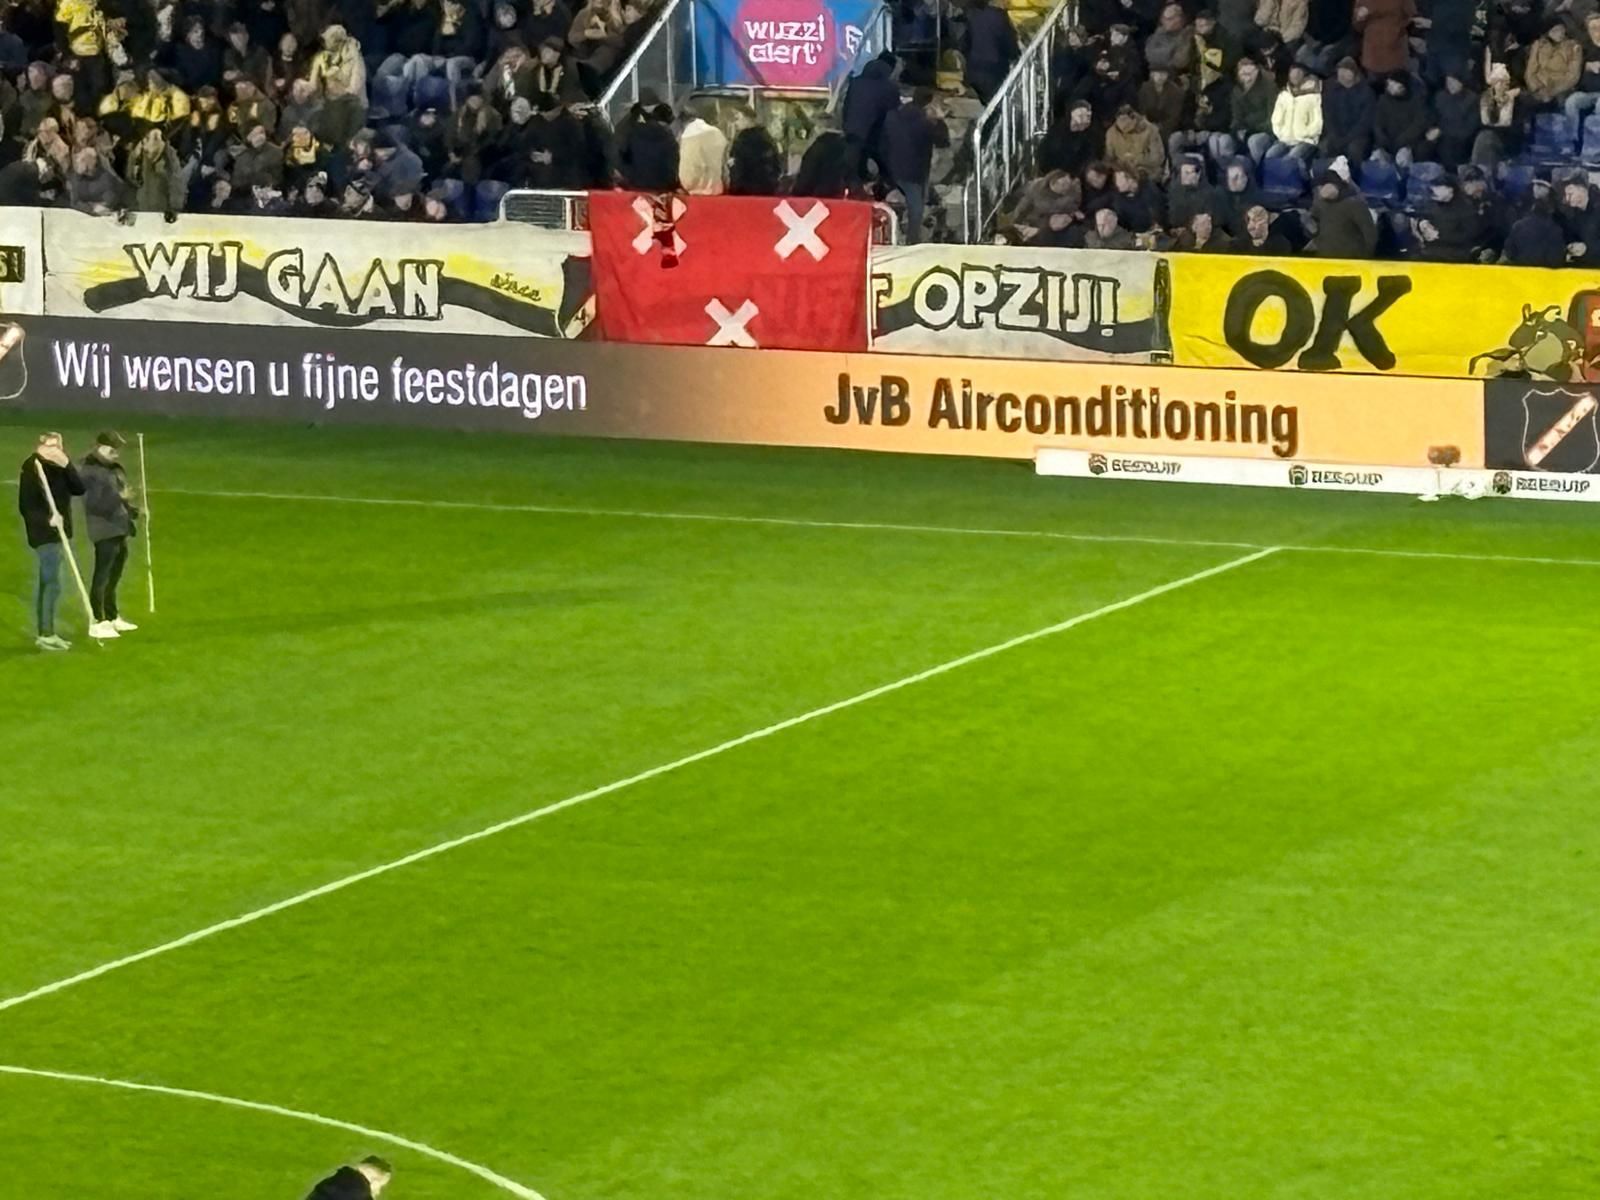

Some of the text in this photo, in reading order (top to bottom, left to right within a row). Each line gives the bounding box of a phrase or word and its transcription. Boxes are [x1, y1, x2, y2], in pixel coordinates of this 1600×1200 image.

[123, 241, 242, 302] WIJ
[264, 247, 444, 320] GAAN
[911, 264, 1120, 337] OPZIJ!
[1223, 270, 1412, 371] OK
[54, 339, 588, 419] Wij wensen u fijne feestdagen
[823, 372, 1299, 458] JvB Airconditioning
